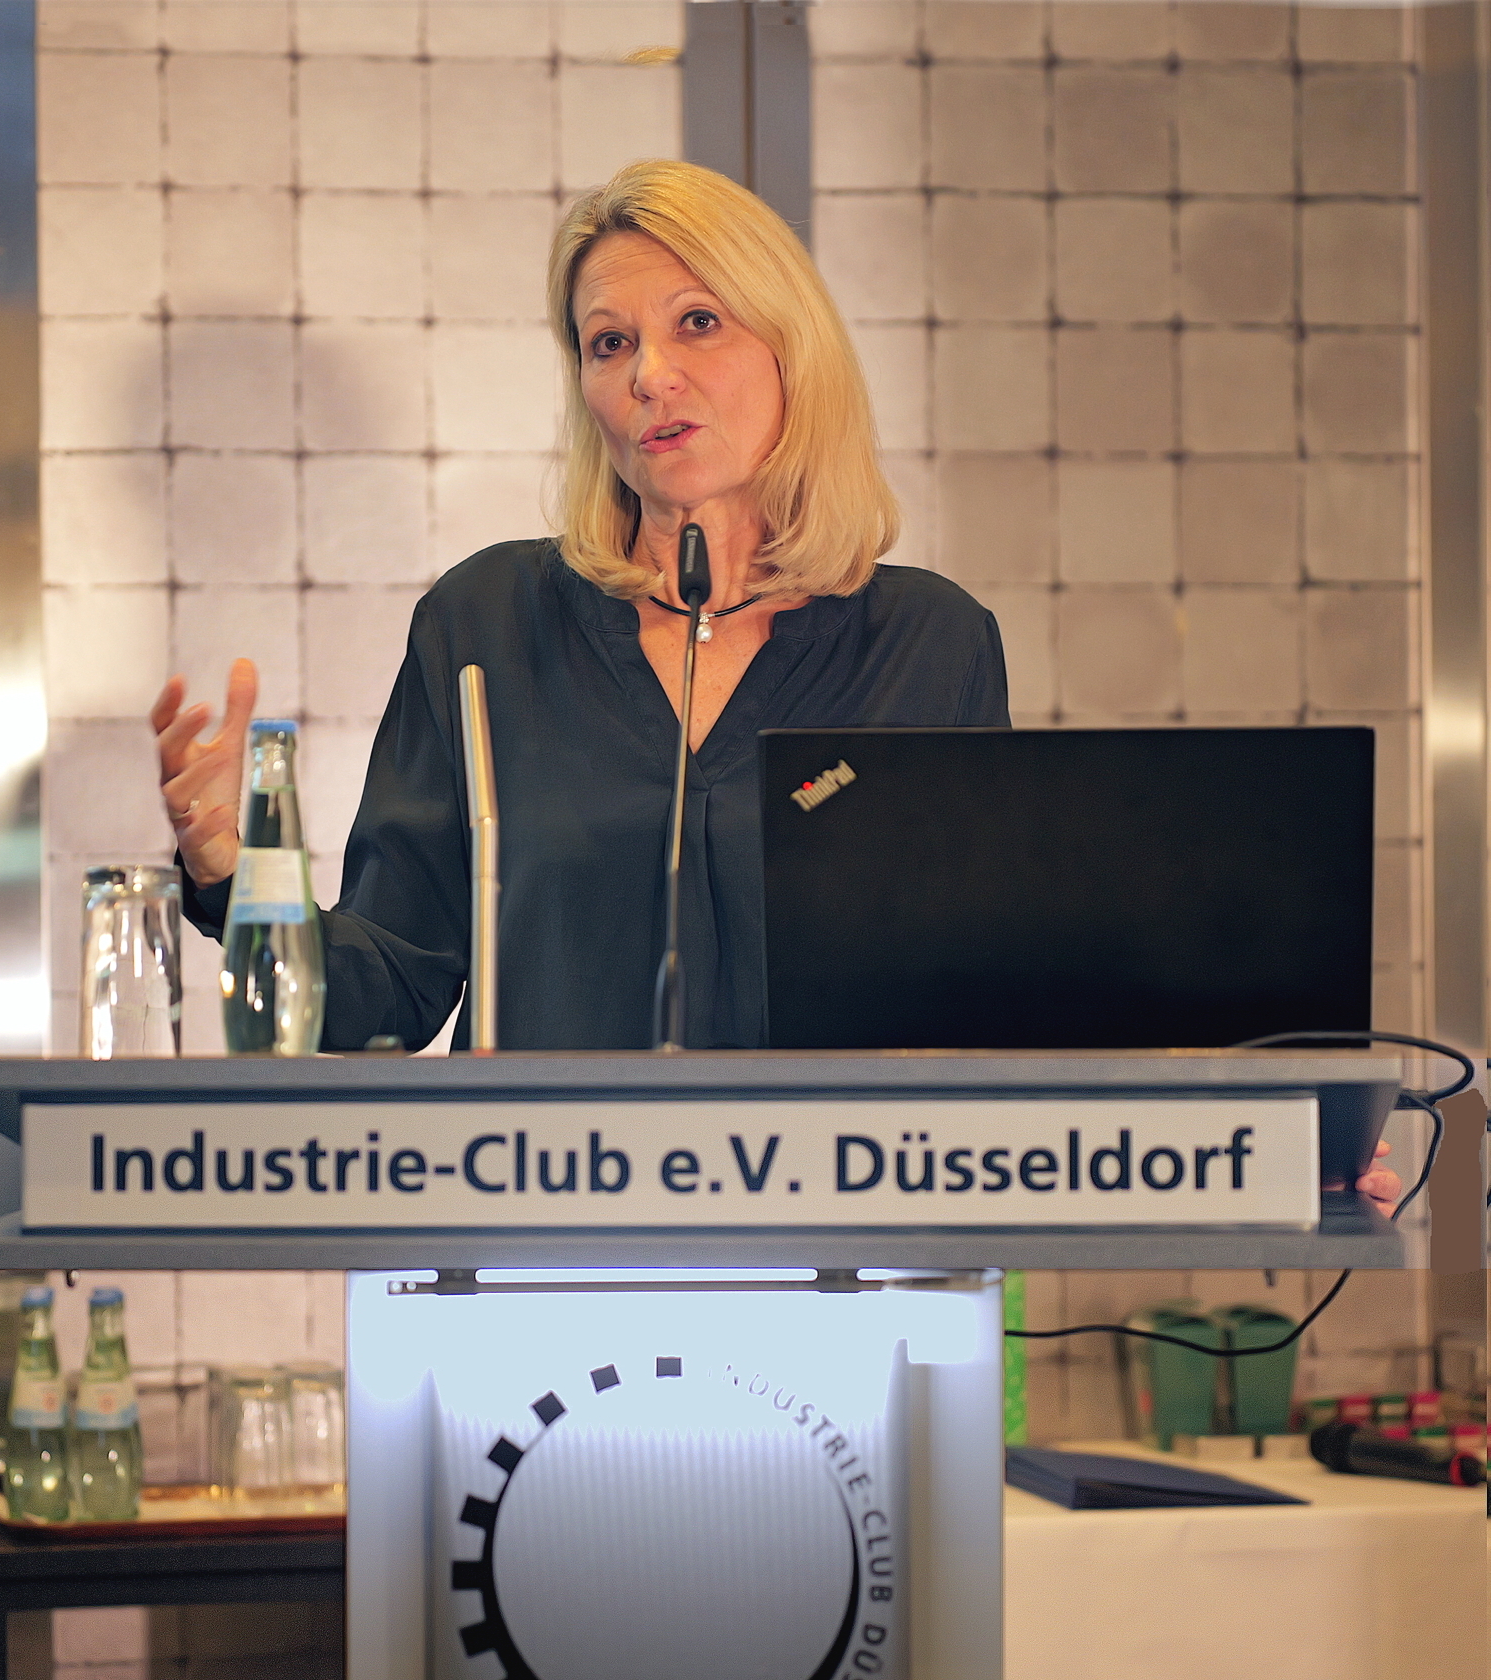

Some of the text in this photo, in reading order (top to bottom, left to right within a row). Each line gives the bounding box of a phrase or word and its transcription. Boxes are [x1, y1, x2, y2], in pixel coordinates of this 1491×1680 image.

[790, 759, 858, 812] ThinkPad
[90, 1126, 1254, 1194] Industrie-Club e.V. Düsseldorf
[708, 1363, 893, 1602] DUSTRIE-CLUB
